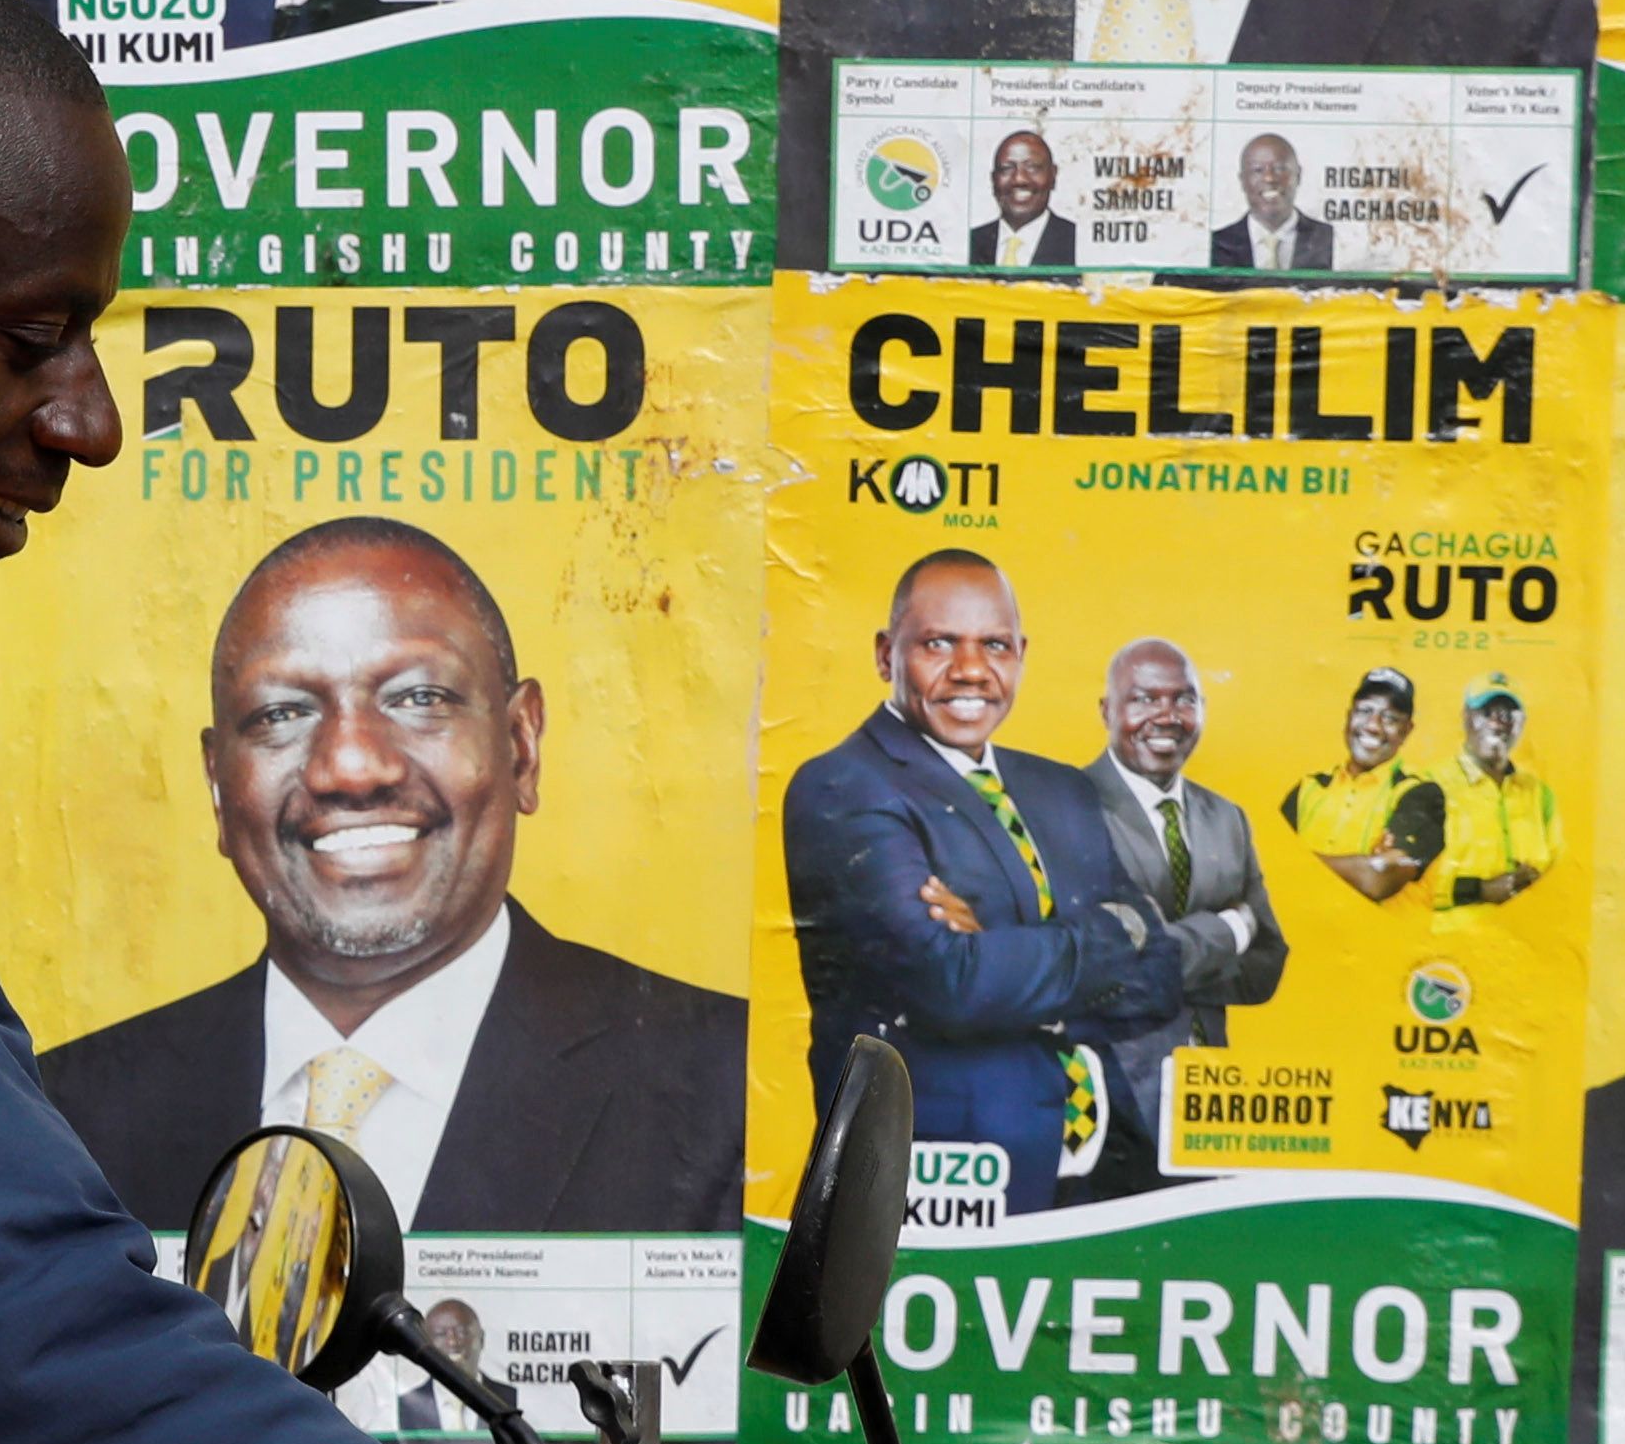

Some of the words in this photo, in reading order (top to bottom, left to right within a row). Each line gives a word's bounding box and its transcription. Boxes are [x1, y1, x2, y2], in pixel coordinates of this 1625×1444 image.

[119, 31, 214, 64] KUMI
[846, 77, 880, 90] Party
[892, 77, 958, 89] Candidate
[846, 93, 894, 106] Symbol
[126, 107, 751, 213] OVERNOR
[1093, 155, 1184, 178] WILLIAM
[1325, 200, 1440, 222] GACHAGUA
[859, 220, 940, 244] UDA
[259, 234, 451, 275] GISHU
[511, 231, 754, 273] COUNTY
[143, 300, 647, 443] RUTO
[849, 313, 1535, 443] CHELILIM
[142, 449, 250, 501] FOR
[294, 449, 645, 502] PRESIDENT
[1075, 462, 1287, 494] JONATHAN
[943, 513, 998, 529] MOJA
[1354, 531, 1558, 560] GACHAGUA
[1348, 564, 1559, 623] RUTO
[1393, 1025, 1479, 1055] UDA
[1258, 1067, 1333, 1087] JOHN
[1183, 1093, 1333, 1125] BAROROT
[1183, 1133, 1242, 1152] DEPUTY
[419, 1250, 463, 1262] Deputy
[467, 1249, 543, 1261] Presidential
[645, 1250, 687, 1262] Voter's
[691, 1250, 723, 1262] Mark
[419, 1266, 490, 1278] Candidate's
[495, 1267, 538, 1278] Names
[645, 1267, 685, 1278] Alama
[708, 1267, 737, 1278] Kura
[508, 1331, 591, 1352] RIGATHI
[883, 1273, 1524, 1388] OVERNOR
[1030, 1396, 1223, 1440] GISHU
